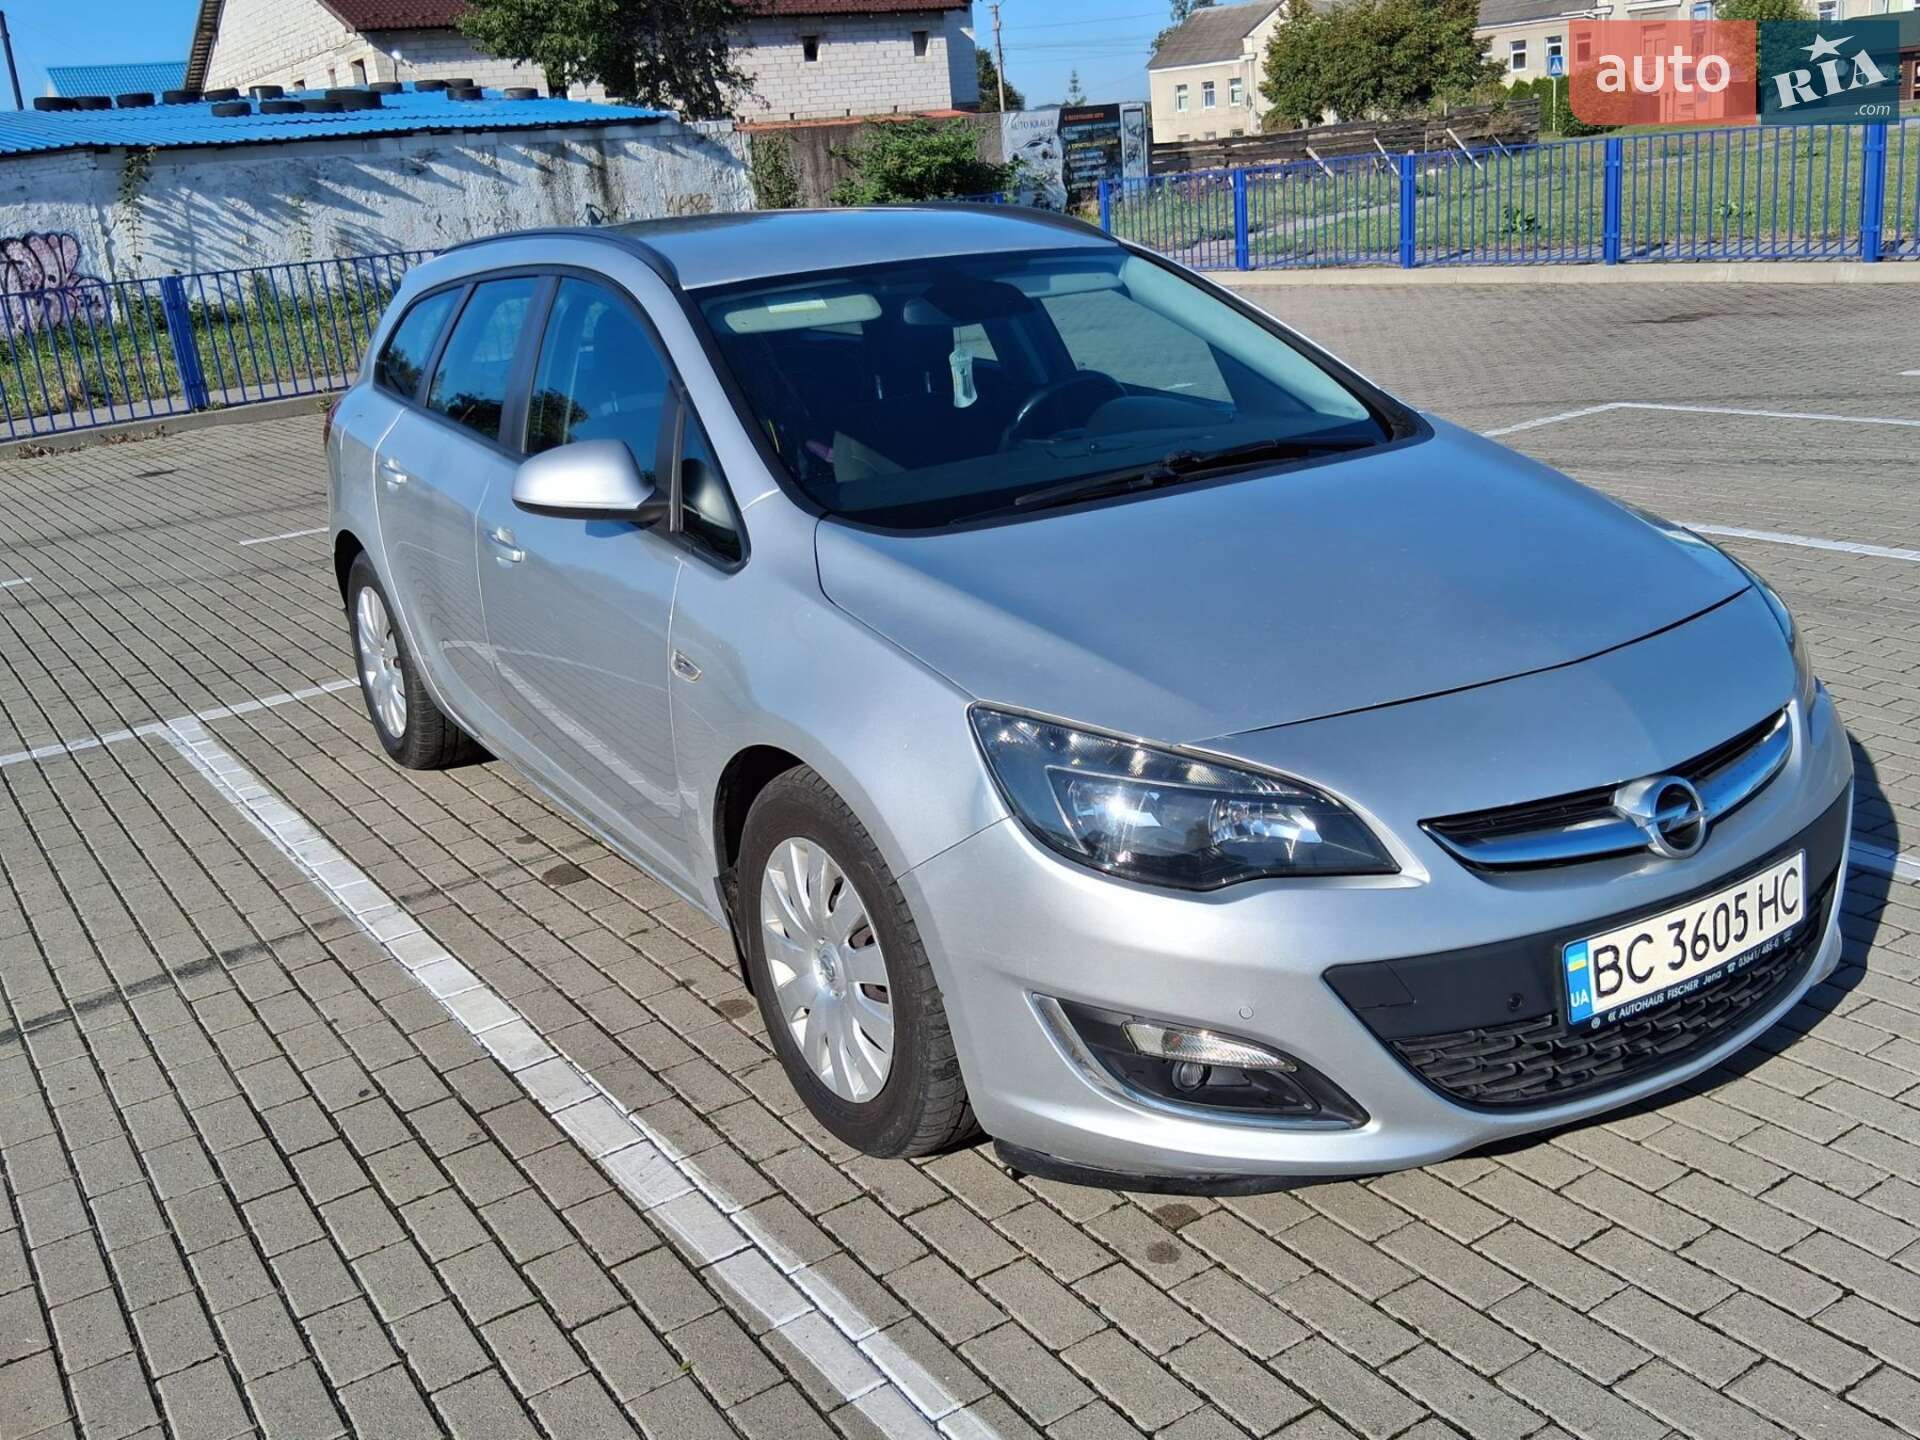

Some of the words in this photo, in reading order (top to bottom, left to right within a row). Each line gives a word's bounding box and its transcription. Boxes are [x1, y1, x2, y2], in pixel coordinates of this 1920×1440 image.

[1593, 932, 1655, 999] BC
[1667, 891, 1749, 972] 3605
[1757, 866, 1799, 931] HC
[1570, 988, 1590, 1008] UA
[1618, 992, 1664, 1019] AUTOHAUS
[1667, 979, 1699, 1000] FISCHER
[1703, 970, 1722, 985] Jena
